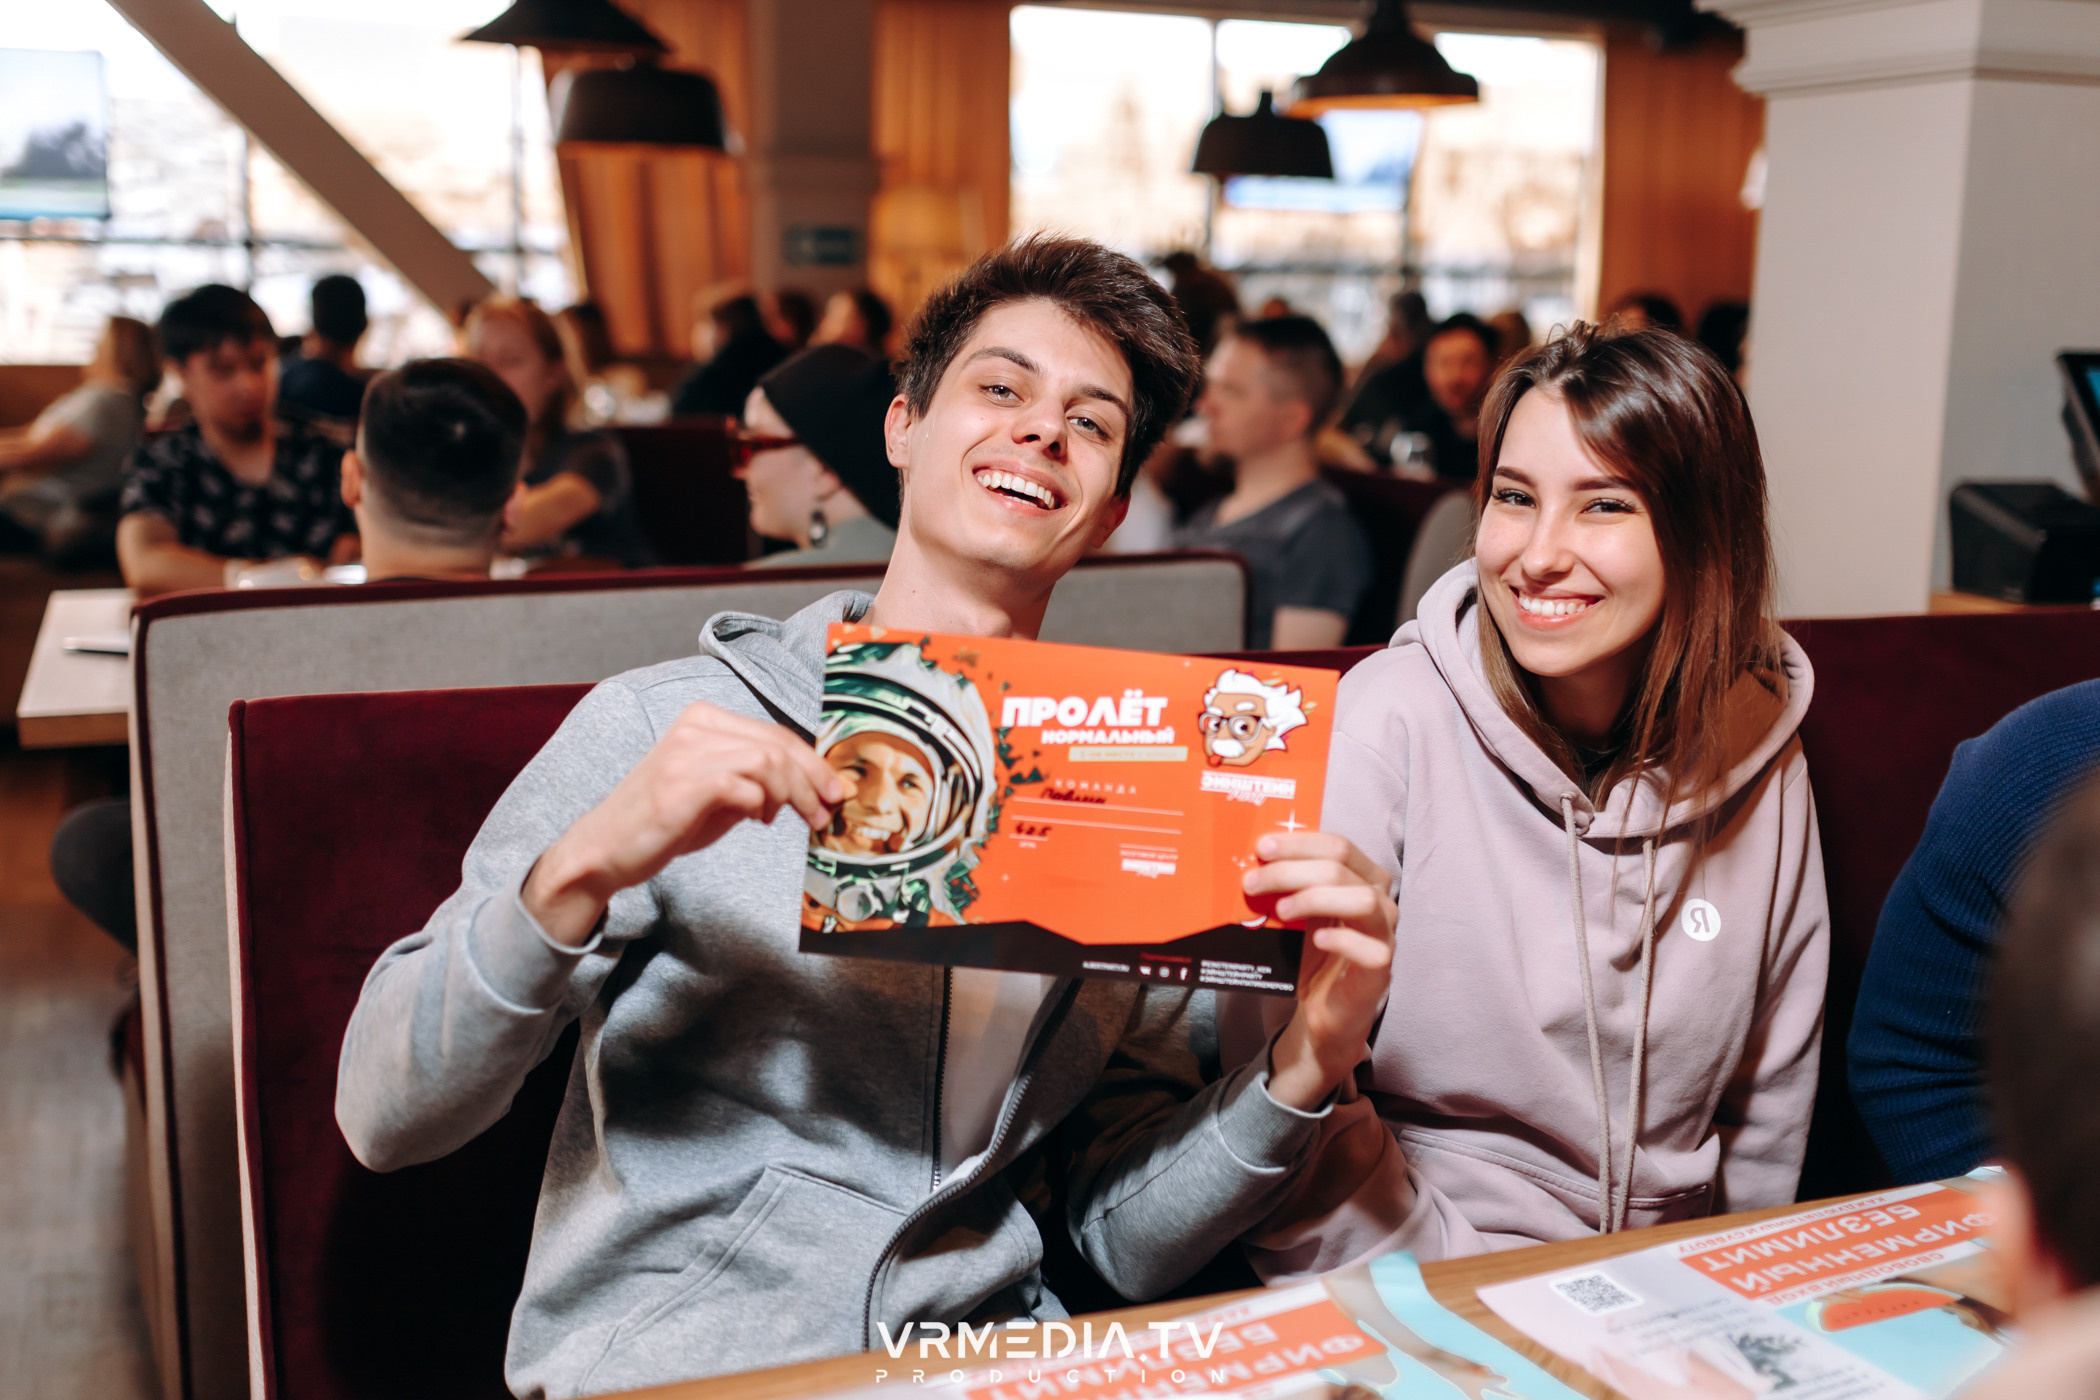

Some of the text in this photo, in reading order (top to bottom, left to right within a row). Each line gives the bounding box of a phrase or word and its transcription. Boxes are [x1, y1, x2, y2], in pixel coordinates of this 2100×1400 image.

[1001, 689, 1168, 727] ПРОЛЁТ
[1041, 727, 1175, 744] НОРМАЛЬНЫЙ
[1055, 779, 1137, 795] КОМАНДА
[1823, 1196, 1887, 1217] КАЖДУЮ
[1759, 1211, 1823, 1233] ПЯТНИЦУ
[1679, 1232, 1746, 1254] СУББОТУ
[1701, 1204, 1921, 1272] БЕЗЛИМИТ
[1730, 1213, 1997, 1292] ФИРМЕННЫЙ
[1765, 1253, 1945, 1306] СВОБОДНЫЙ ВХОД
